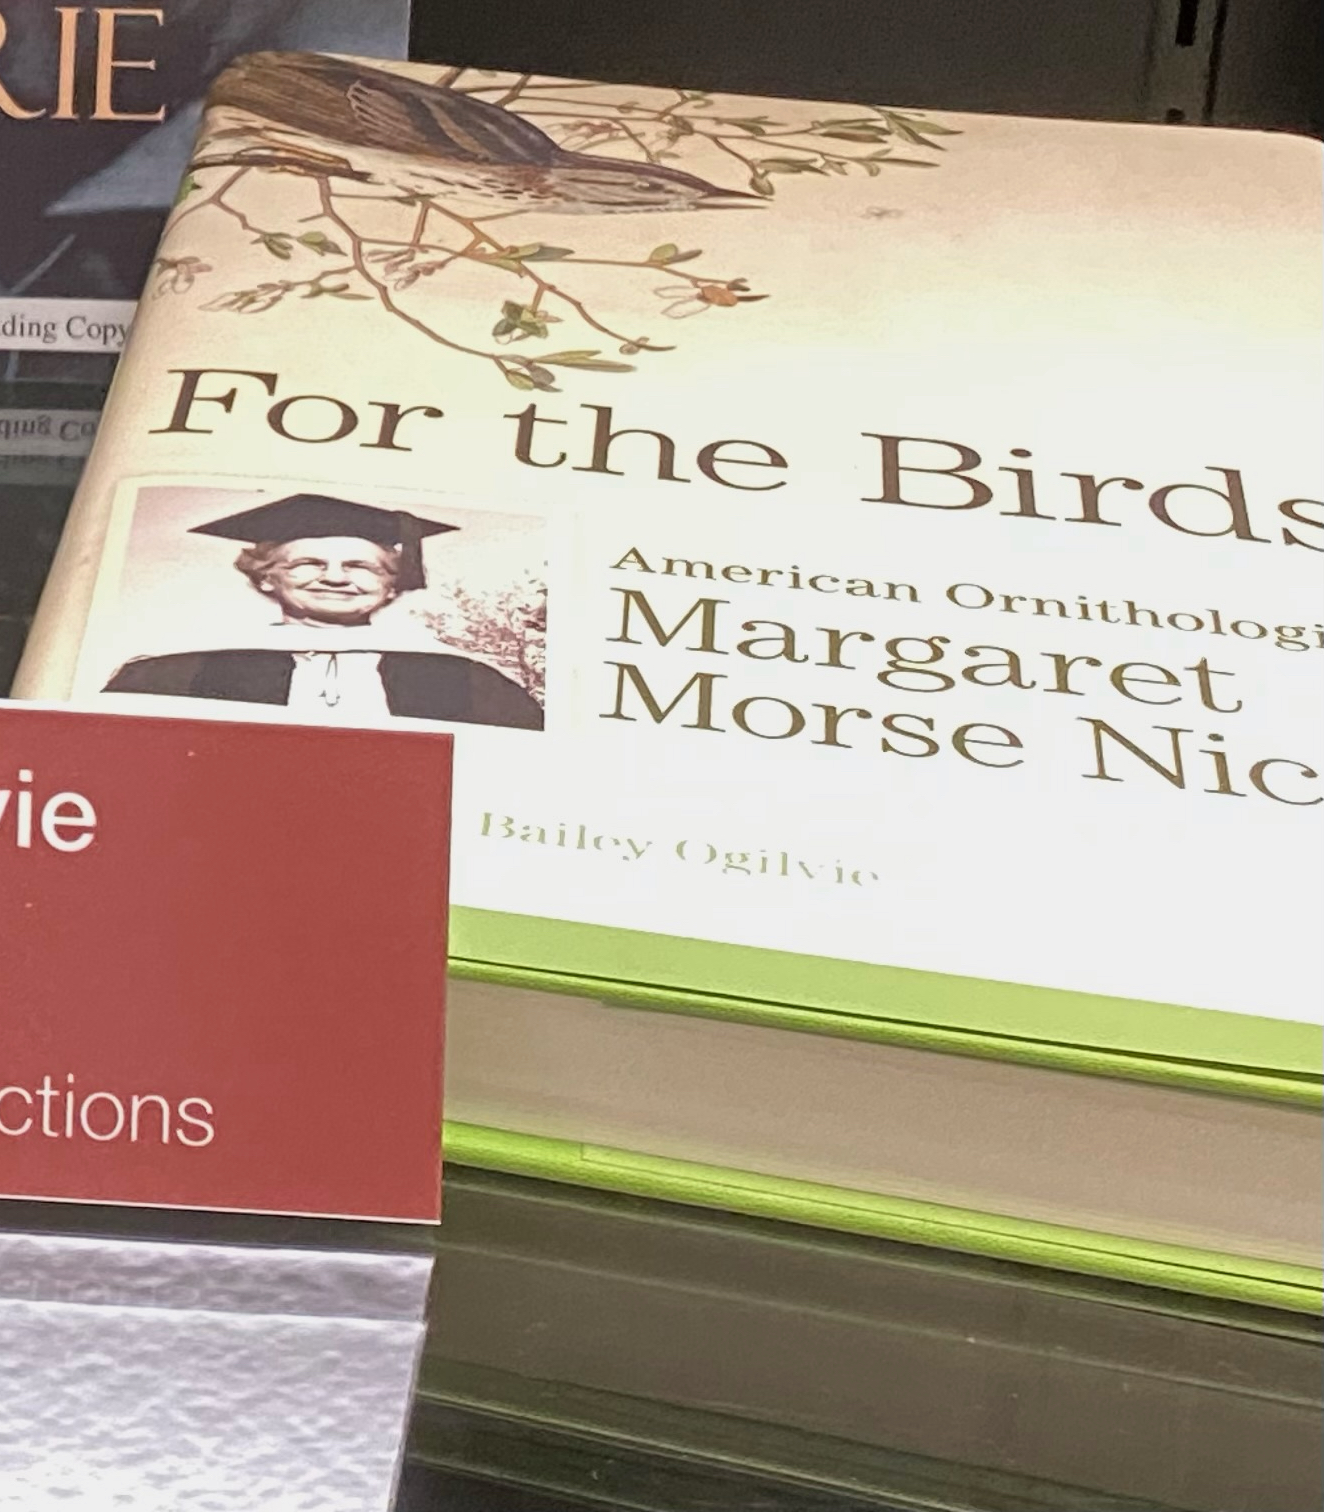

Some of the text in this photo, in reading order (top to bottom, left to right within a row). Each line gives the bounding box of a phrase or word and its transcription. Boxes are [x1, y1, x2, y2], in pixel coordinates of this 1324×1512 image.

[65, 316, 129, 347] Copy
[147, 367, 445, 454] For
[502, 400, 790, 495] the
[609, 544, 922, 606] American
[606, 584, 1243, 715] Margaret
[599, 660, 1324, 807] Morse Nic
[480, 811, 880, 888] Bailey Ogilvie
